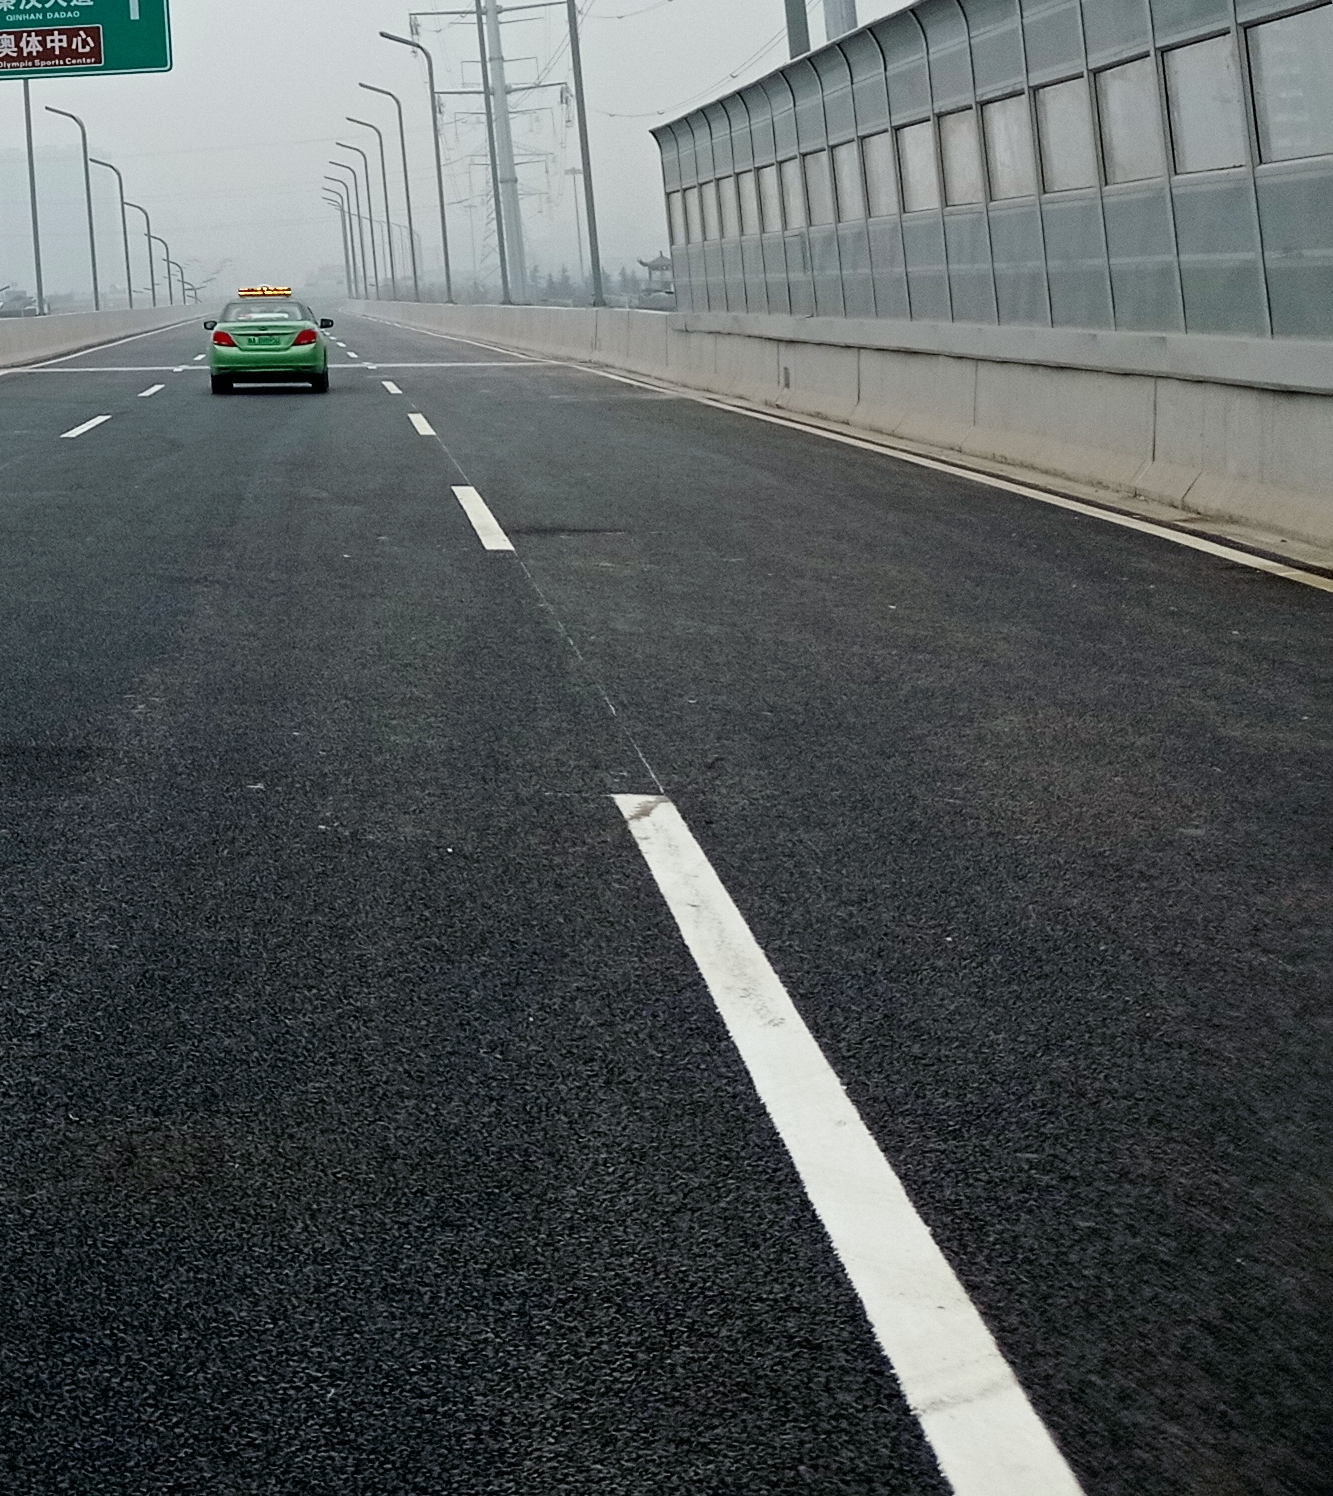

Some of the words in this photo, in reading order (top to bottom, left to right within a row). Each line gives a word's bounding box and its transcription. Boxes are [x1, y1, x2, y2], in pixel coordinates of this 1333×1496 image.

[6, 13, 43, 21] QINHAN
[46, 11, 80, 19] DADAO
[34, 58, 64, 67] Sports
[65, 57, 96, 65] Center
